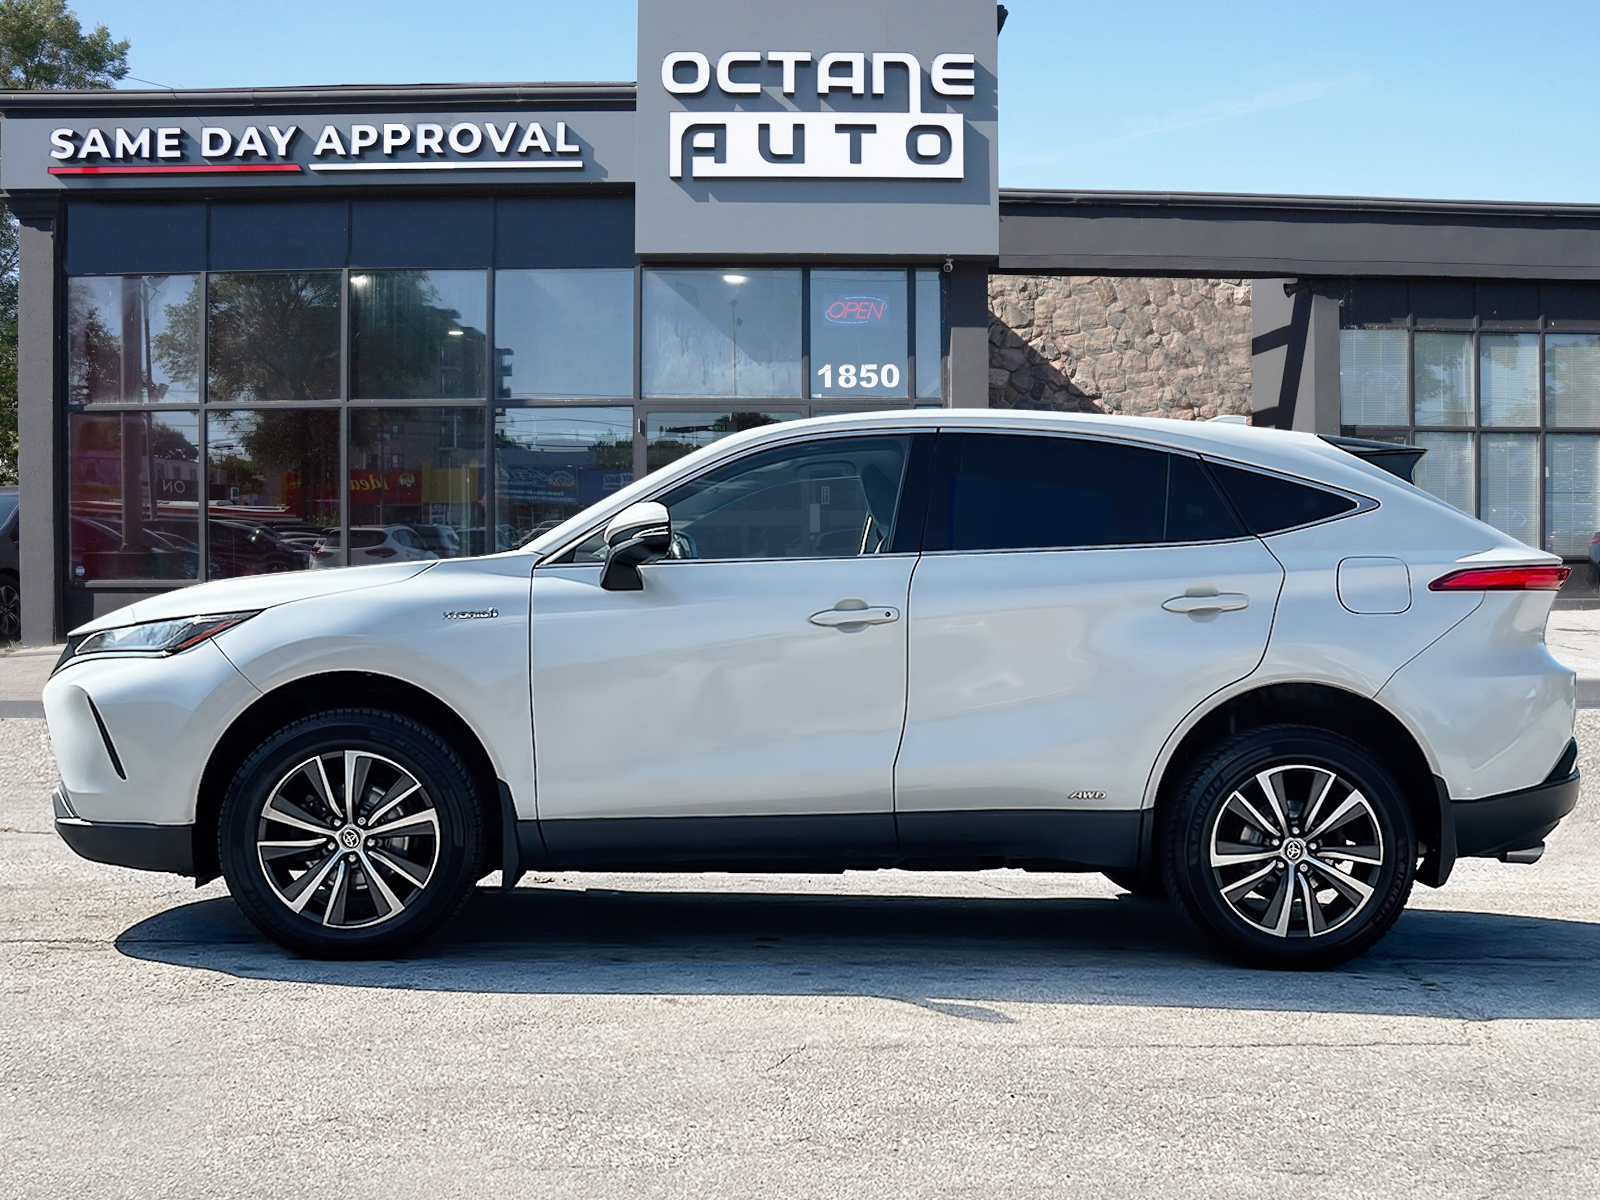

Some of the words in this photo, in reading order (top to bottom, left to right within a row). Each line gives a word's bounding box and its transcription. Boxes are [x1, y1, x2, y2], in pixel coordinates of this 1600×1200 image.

[660, 51, 976, 113] OCTANE
[48, 126, 182, 161] SAME
[200, 124, 299, 158] DAY
[311, 120, 580, 156] APPROVAL
[680, 122, 953, 178] AUTO
[829, 301, 885, 319] OPEN
[817, 363, 900, 389] 1850
[1067, 790, 1108, 800] AWD
